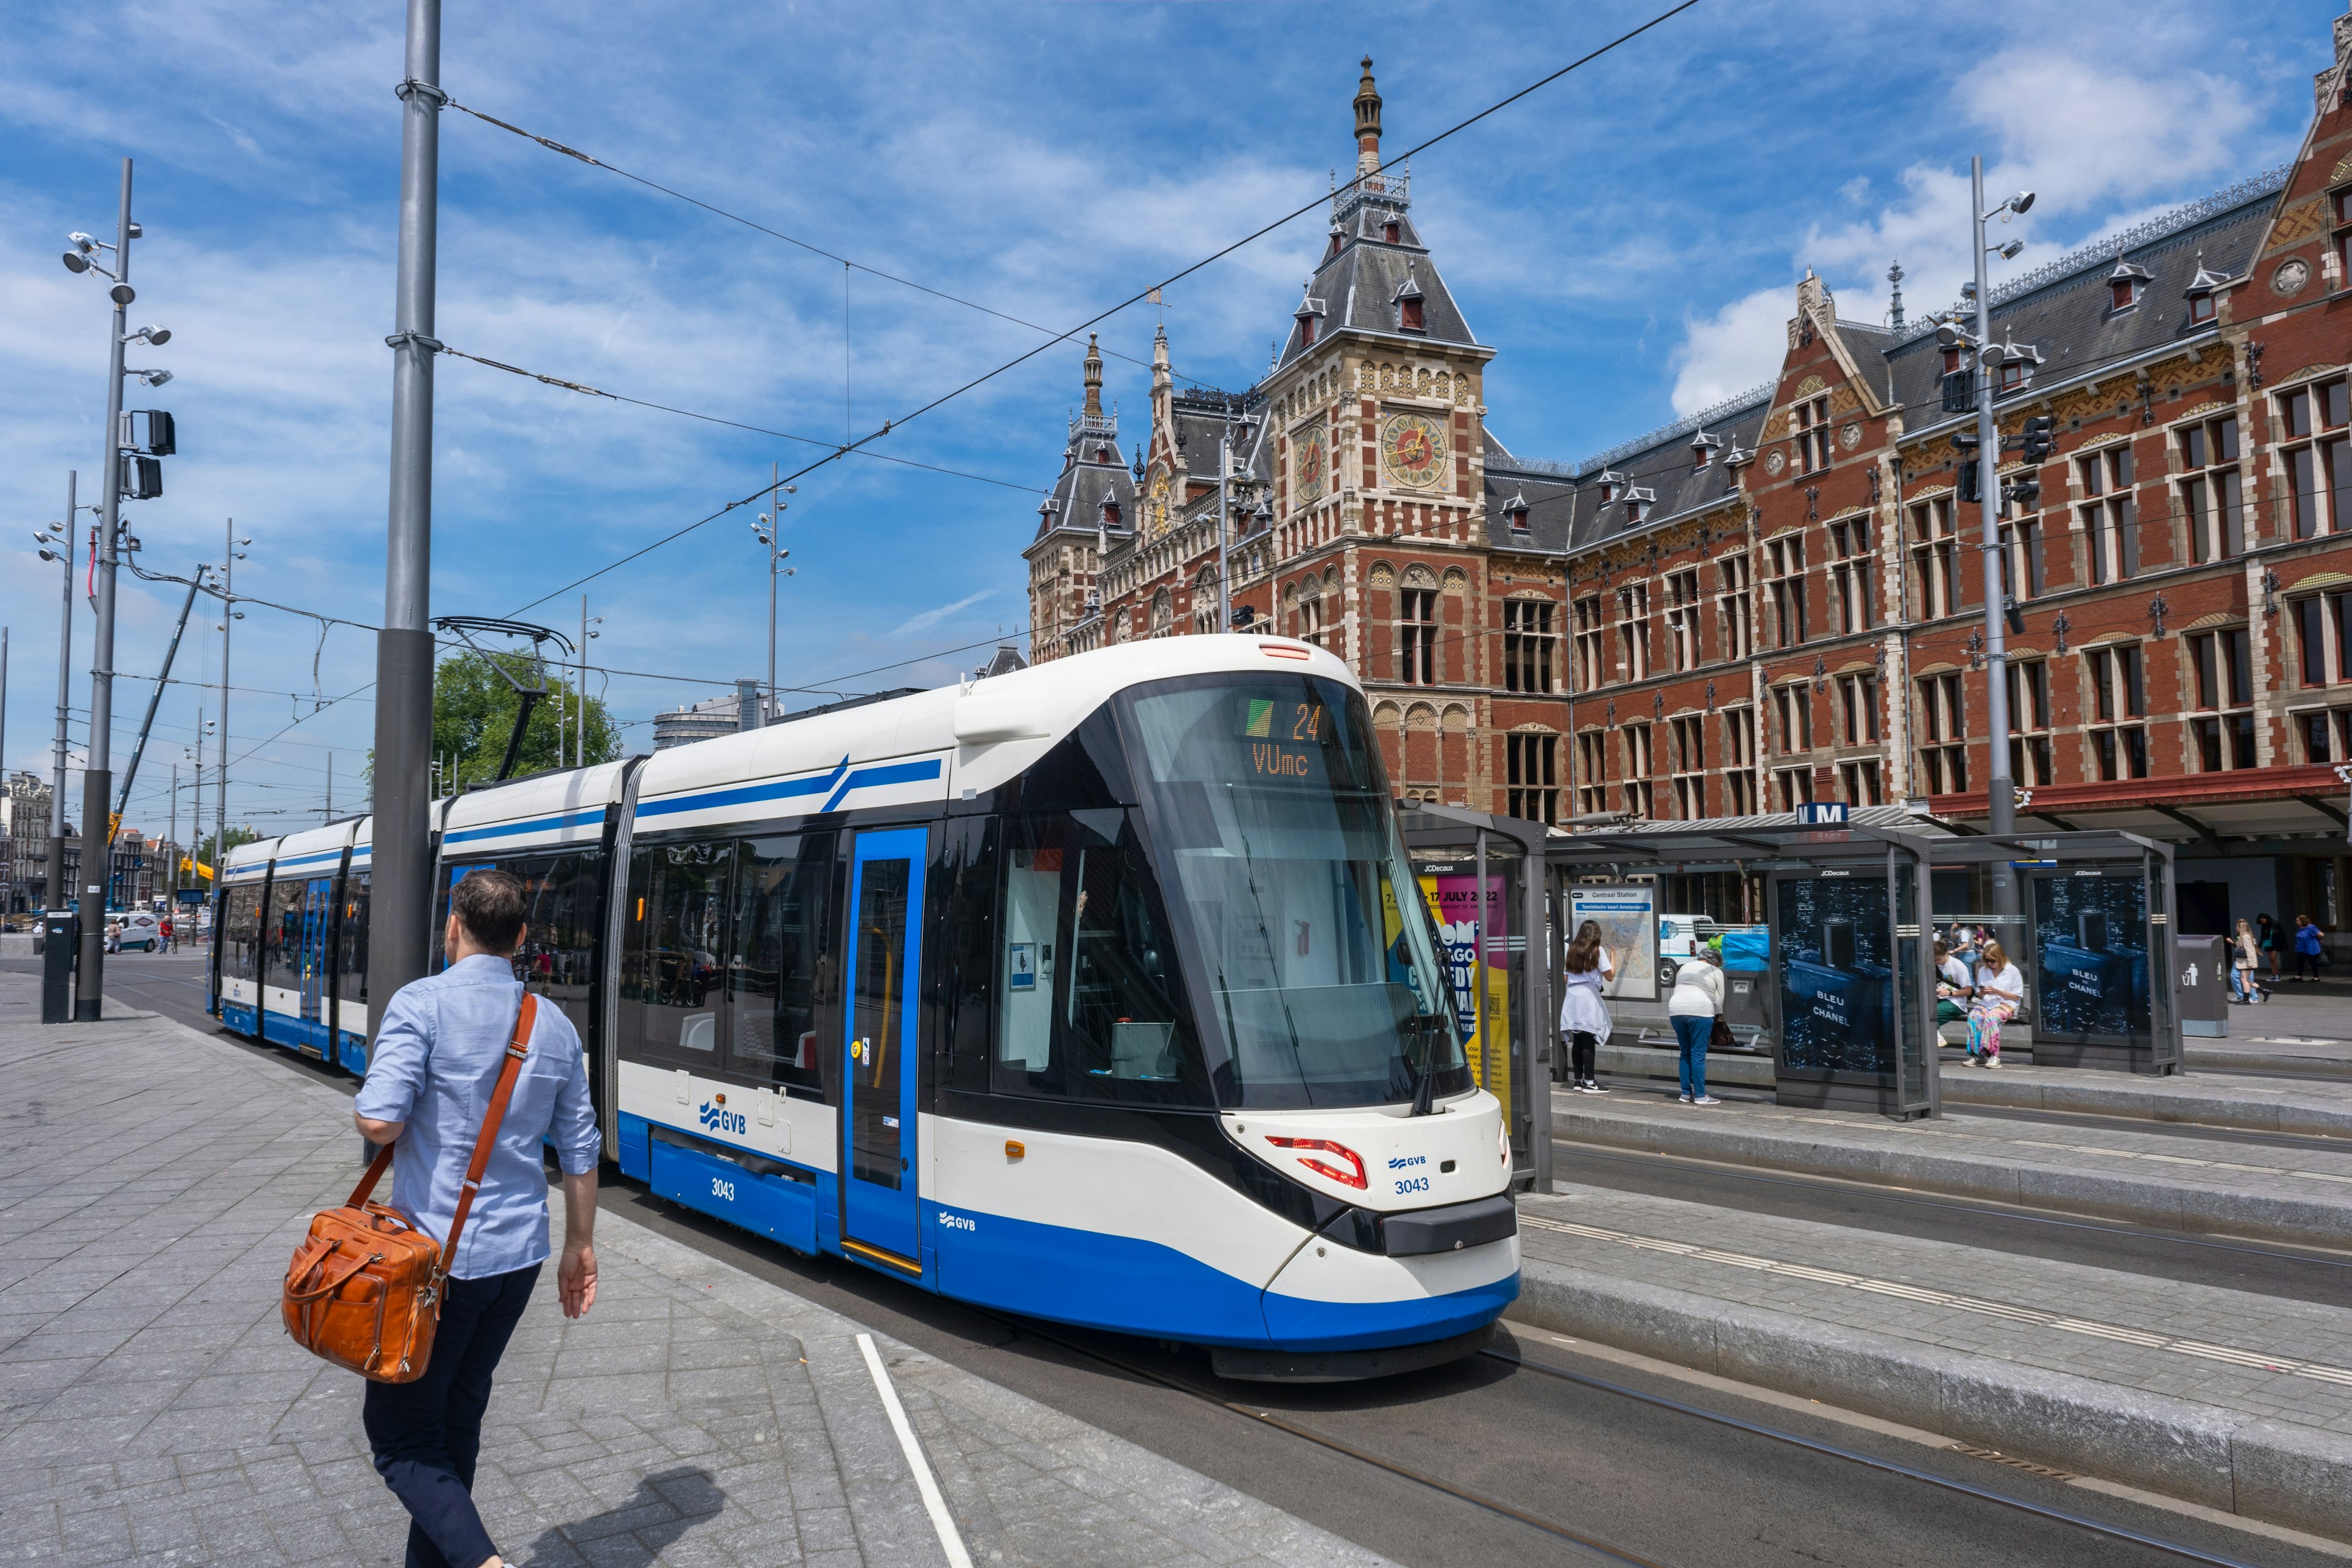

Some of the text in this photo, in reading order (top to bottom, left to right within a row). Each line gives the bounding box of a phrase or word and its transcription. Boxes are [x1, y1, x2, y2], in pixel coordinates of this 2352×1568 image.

[1294, 704, 1321, 741] 24
[1253, 744, 1308, 775] VUmc
[1817, 805, 1842, 823] M
[1430, 892, 1439, 902] 17
[1443, 892, 1468, 902] JULY
[1471, 891, 1498, 902] 222
[2072, 968, 2097, 981] BLEU
[1817, 990, 1844, 1006] BLEU
[2068, 982, 2103, 998] CHANEL
[1813, 1006, 1850, 1027] CHANEL
[722, 1110, 745, 1134] GVB
[1408, 1156, 1426, 1166] GVB
[712, 1177, 734, 1201] 3043
[1395, 1177, 1429, 1194] 3043
[956, 1217, 976, 1231] GVB
